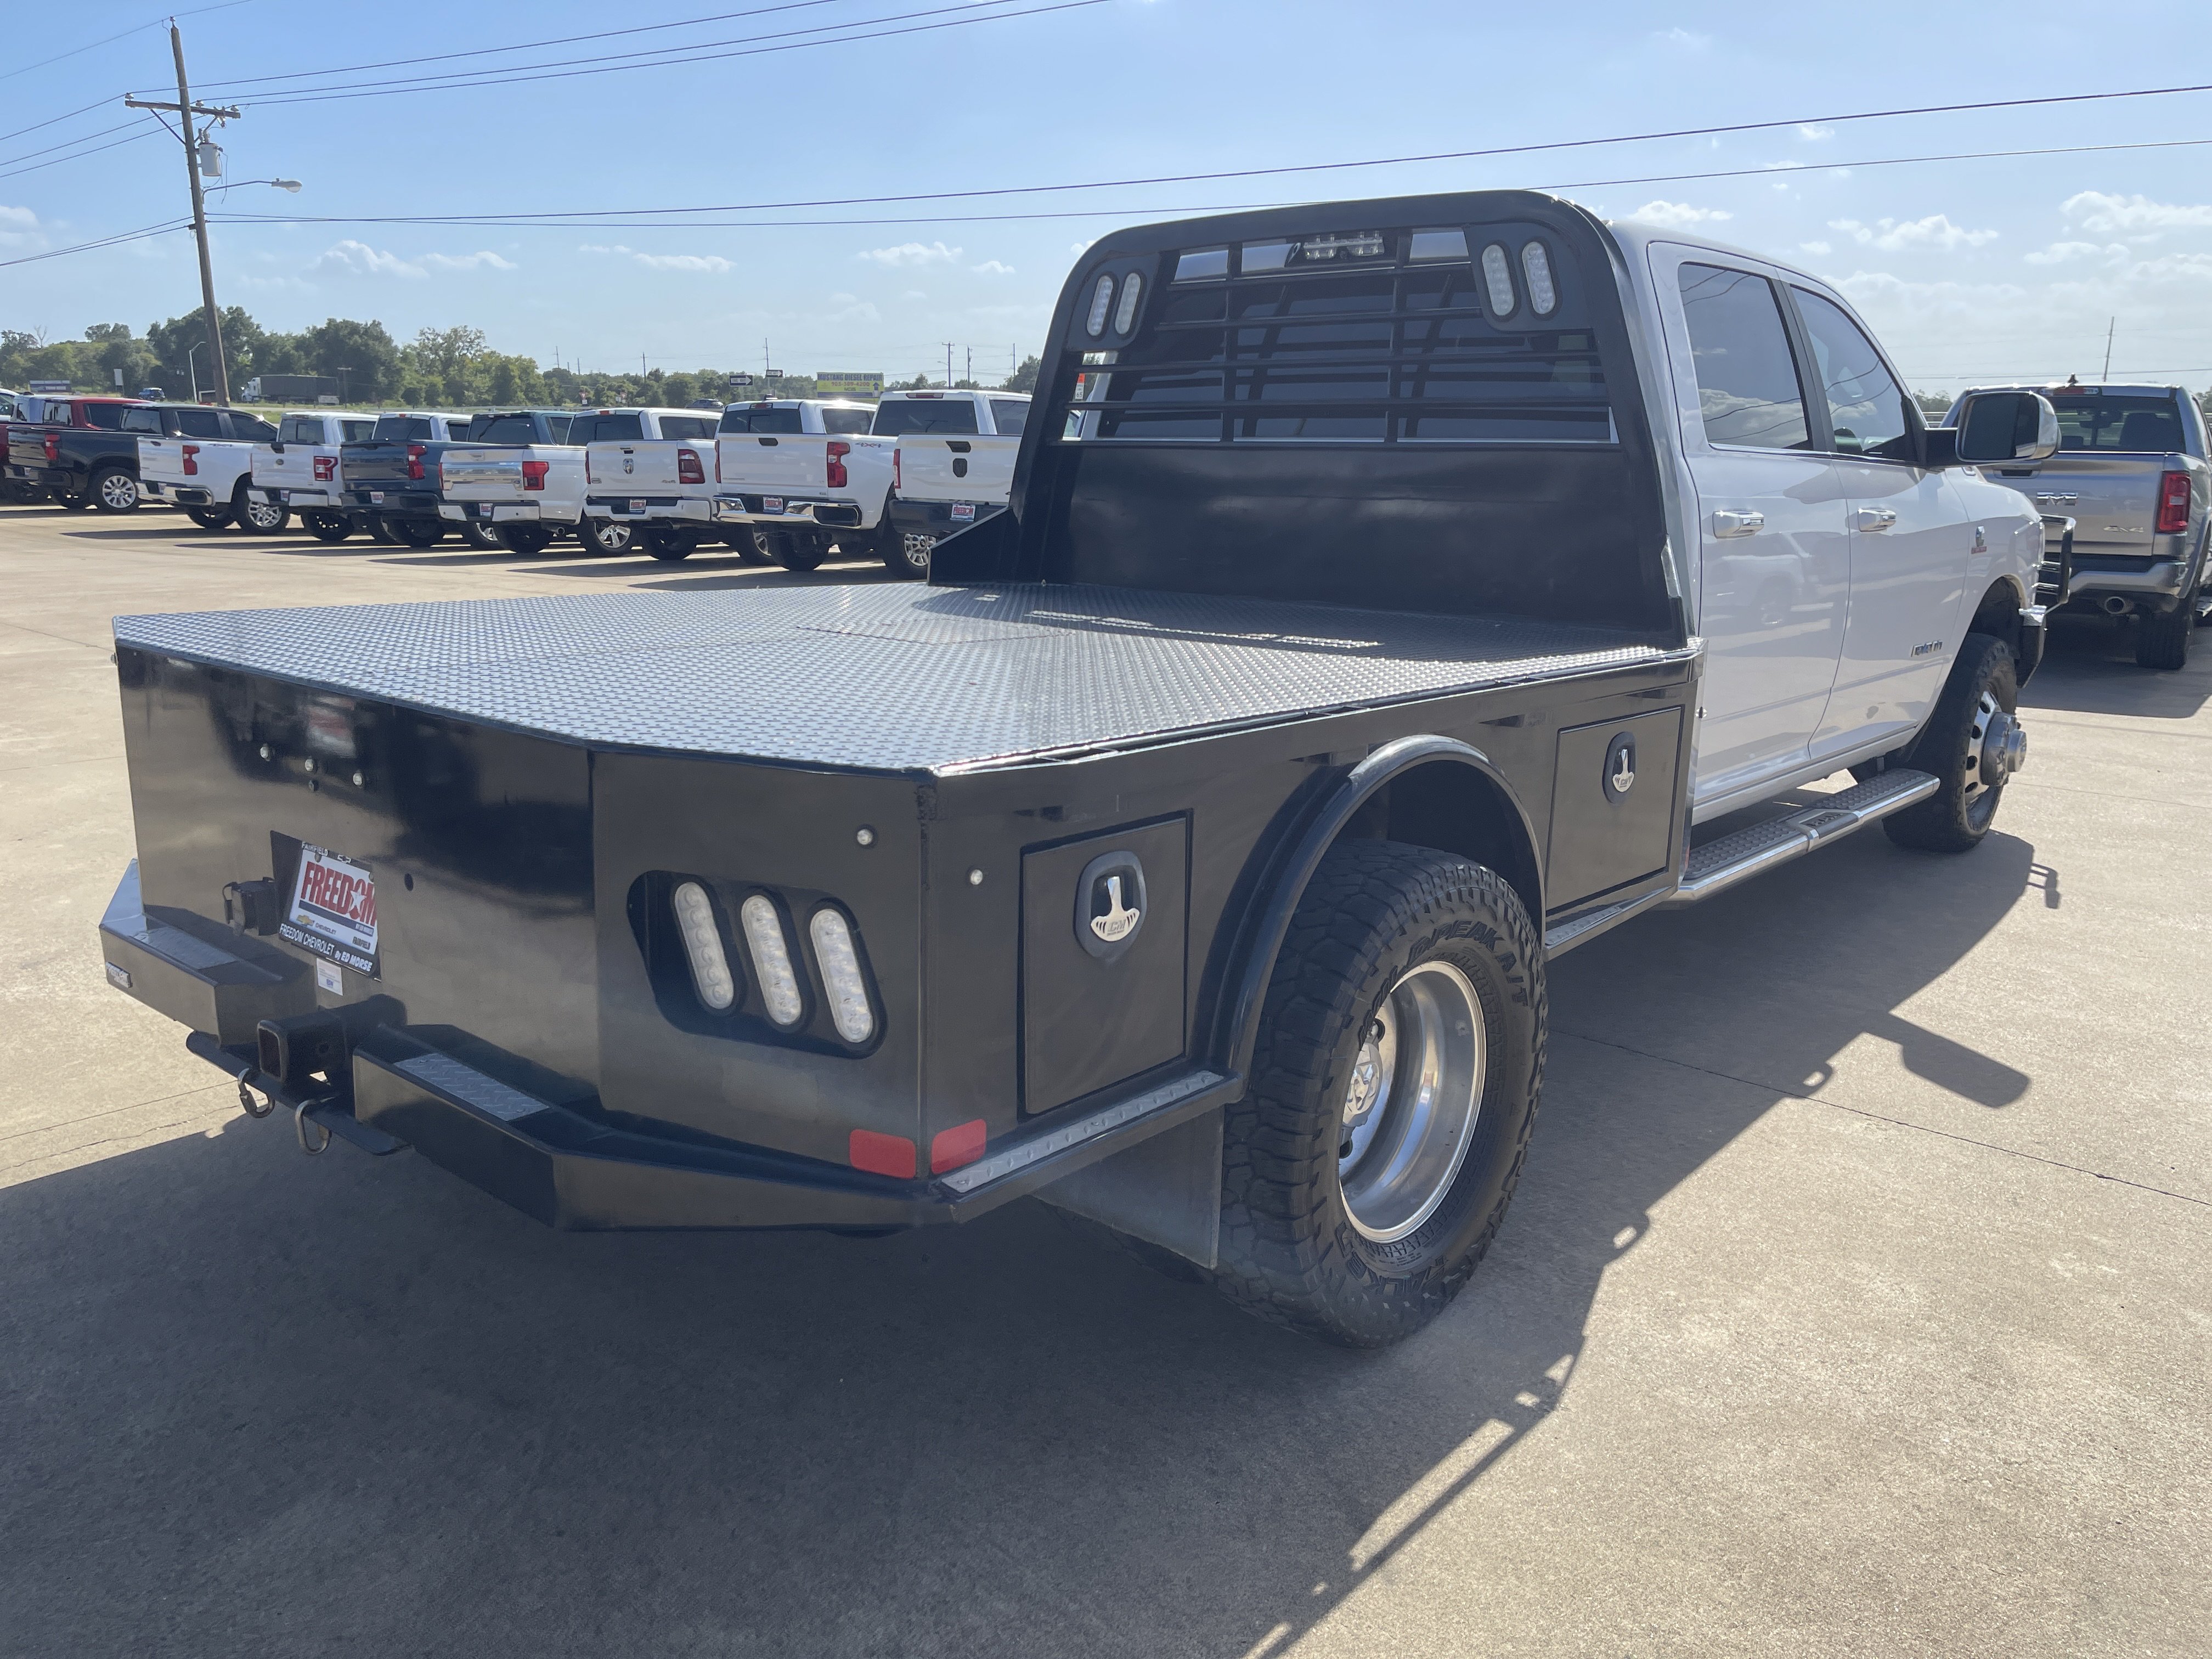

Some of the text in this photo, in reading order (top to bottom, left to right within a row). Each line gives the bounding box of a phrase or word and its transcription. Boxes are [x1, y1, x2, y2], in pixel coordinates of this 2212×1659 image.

[1910, 639, 1943, 657] RAM
[300, 861, 377, 927] FREEDOM
[315, 922, 337, 935] CHEVROLET
[279, 923, 304, 943] FREEDOM
[303, 933, 335, 956] CHEVROLET
[340, 951, 351, 963] ED
[348, 954, 373, 972] MORSE
